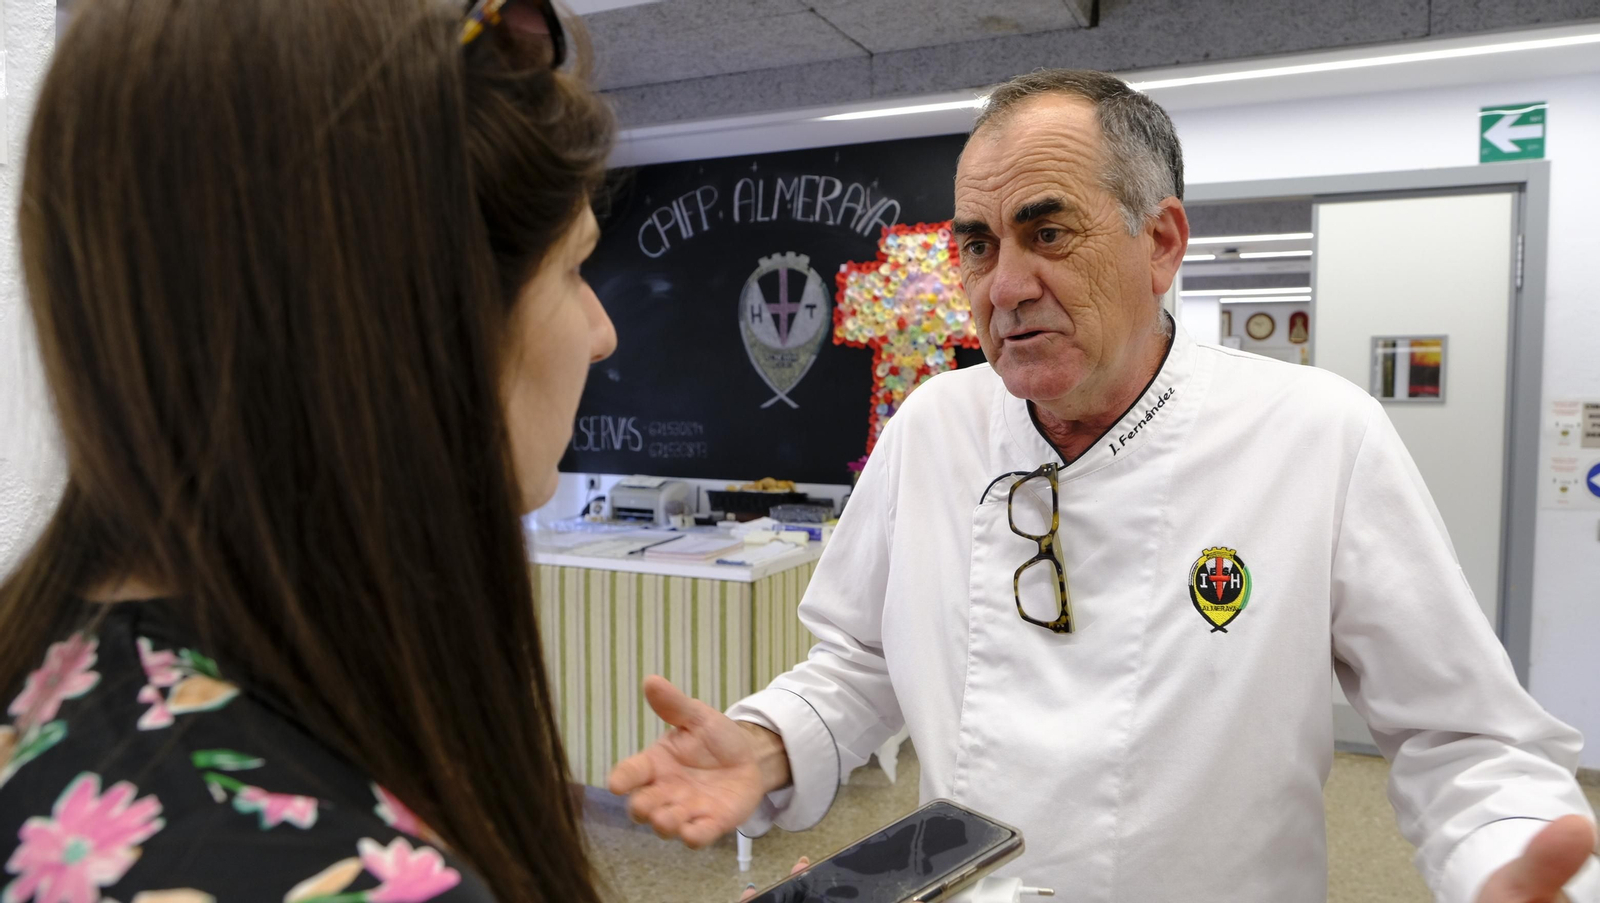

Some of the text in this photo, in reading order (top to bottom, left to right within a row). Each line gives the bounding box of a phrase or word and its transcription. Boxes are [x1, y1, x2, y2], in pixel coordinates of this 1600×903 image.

[750, 303, 818, 324] H T
[1119, 387, 1175, 446] Fernández
[573, 415, 643, 451] ESERVAS
[1231, 573, 1240, 588] H
